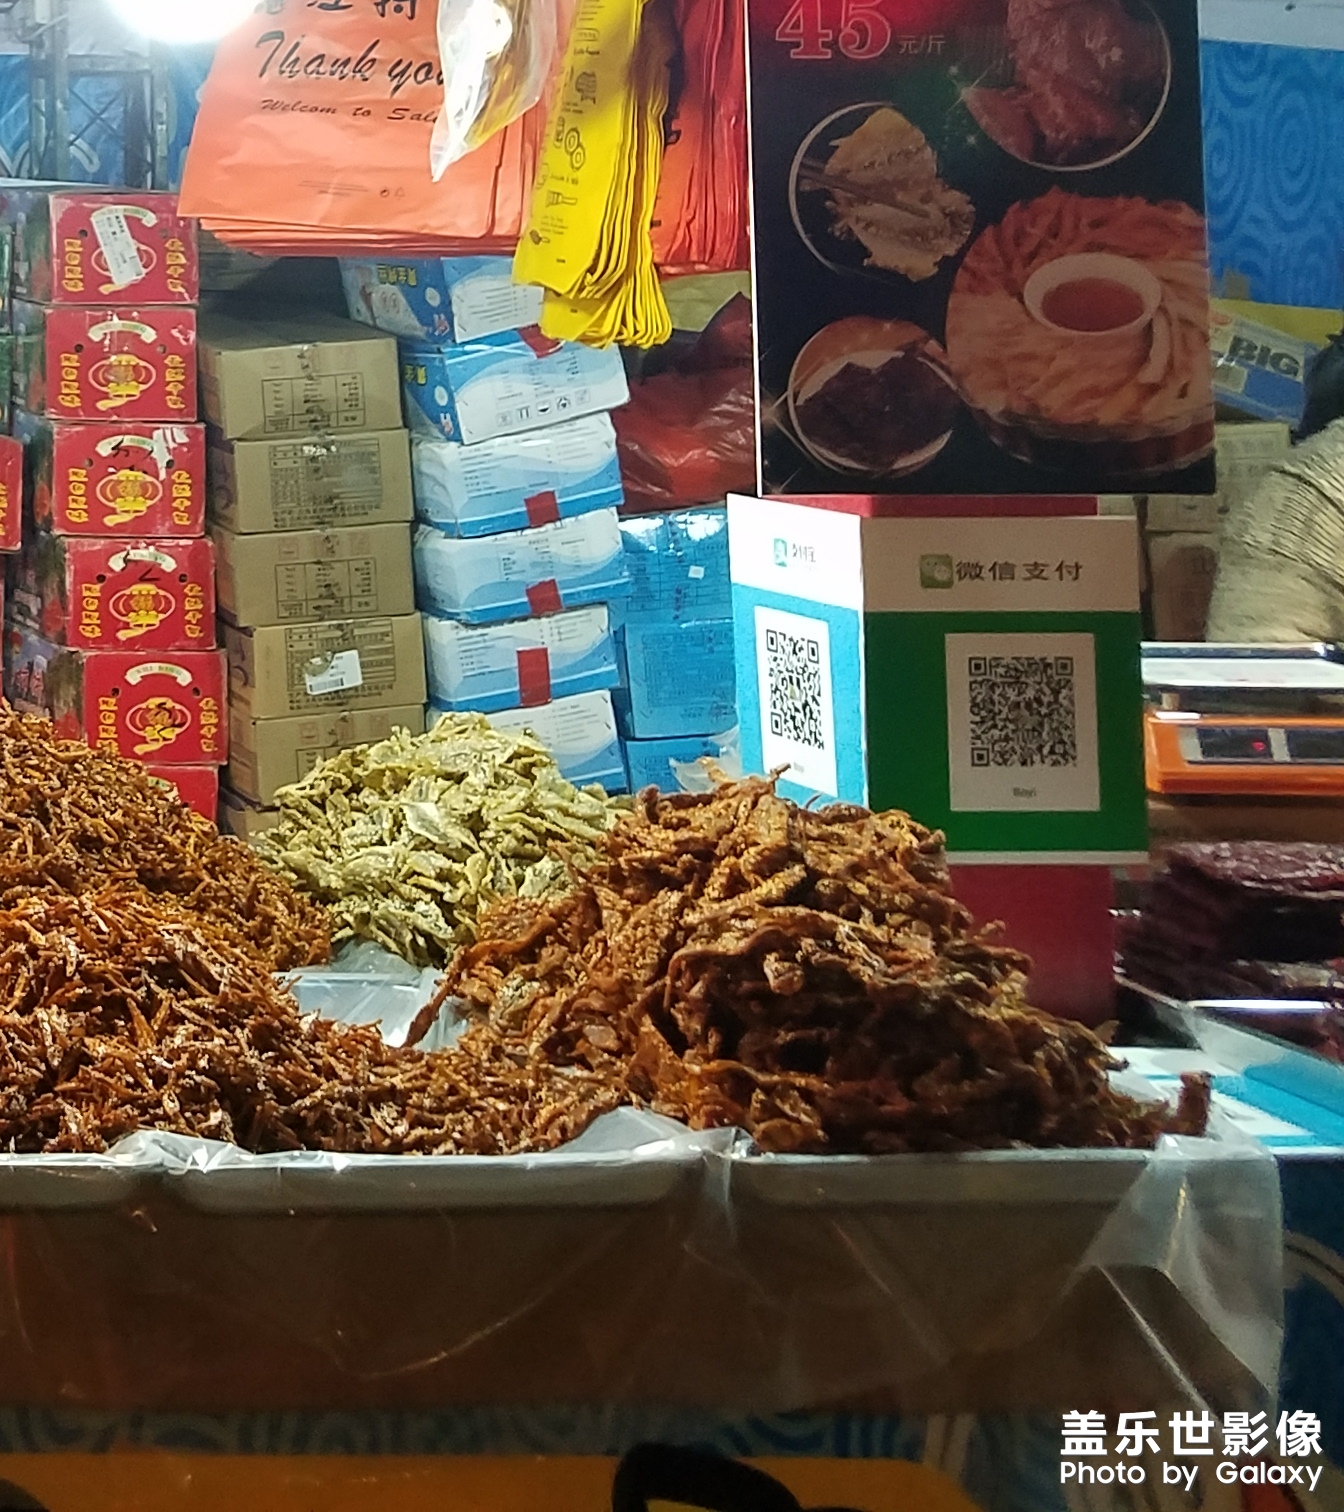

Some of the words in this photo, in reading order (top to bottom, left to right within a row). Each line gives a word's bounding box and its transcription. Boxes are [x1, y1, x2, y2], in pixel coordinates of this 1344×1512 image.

[255, 30, 381, 82] Thank
[897, 32, 947, 56] 元/斤
[261, 98, 337, 116] Welcom
[352, 105, 372, 118] to
[1227, 336, 1303, 377] BIG
[955, 559, 1084, 583] 微信支付
